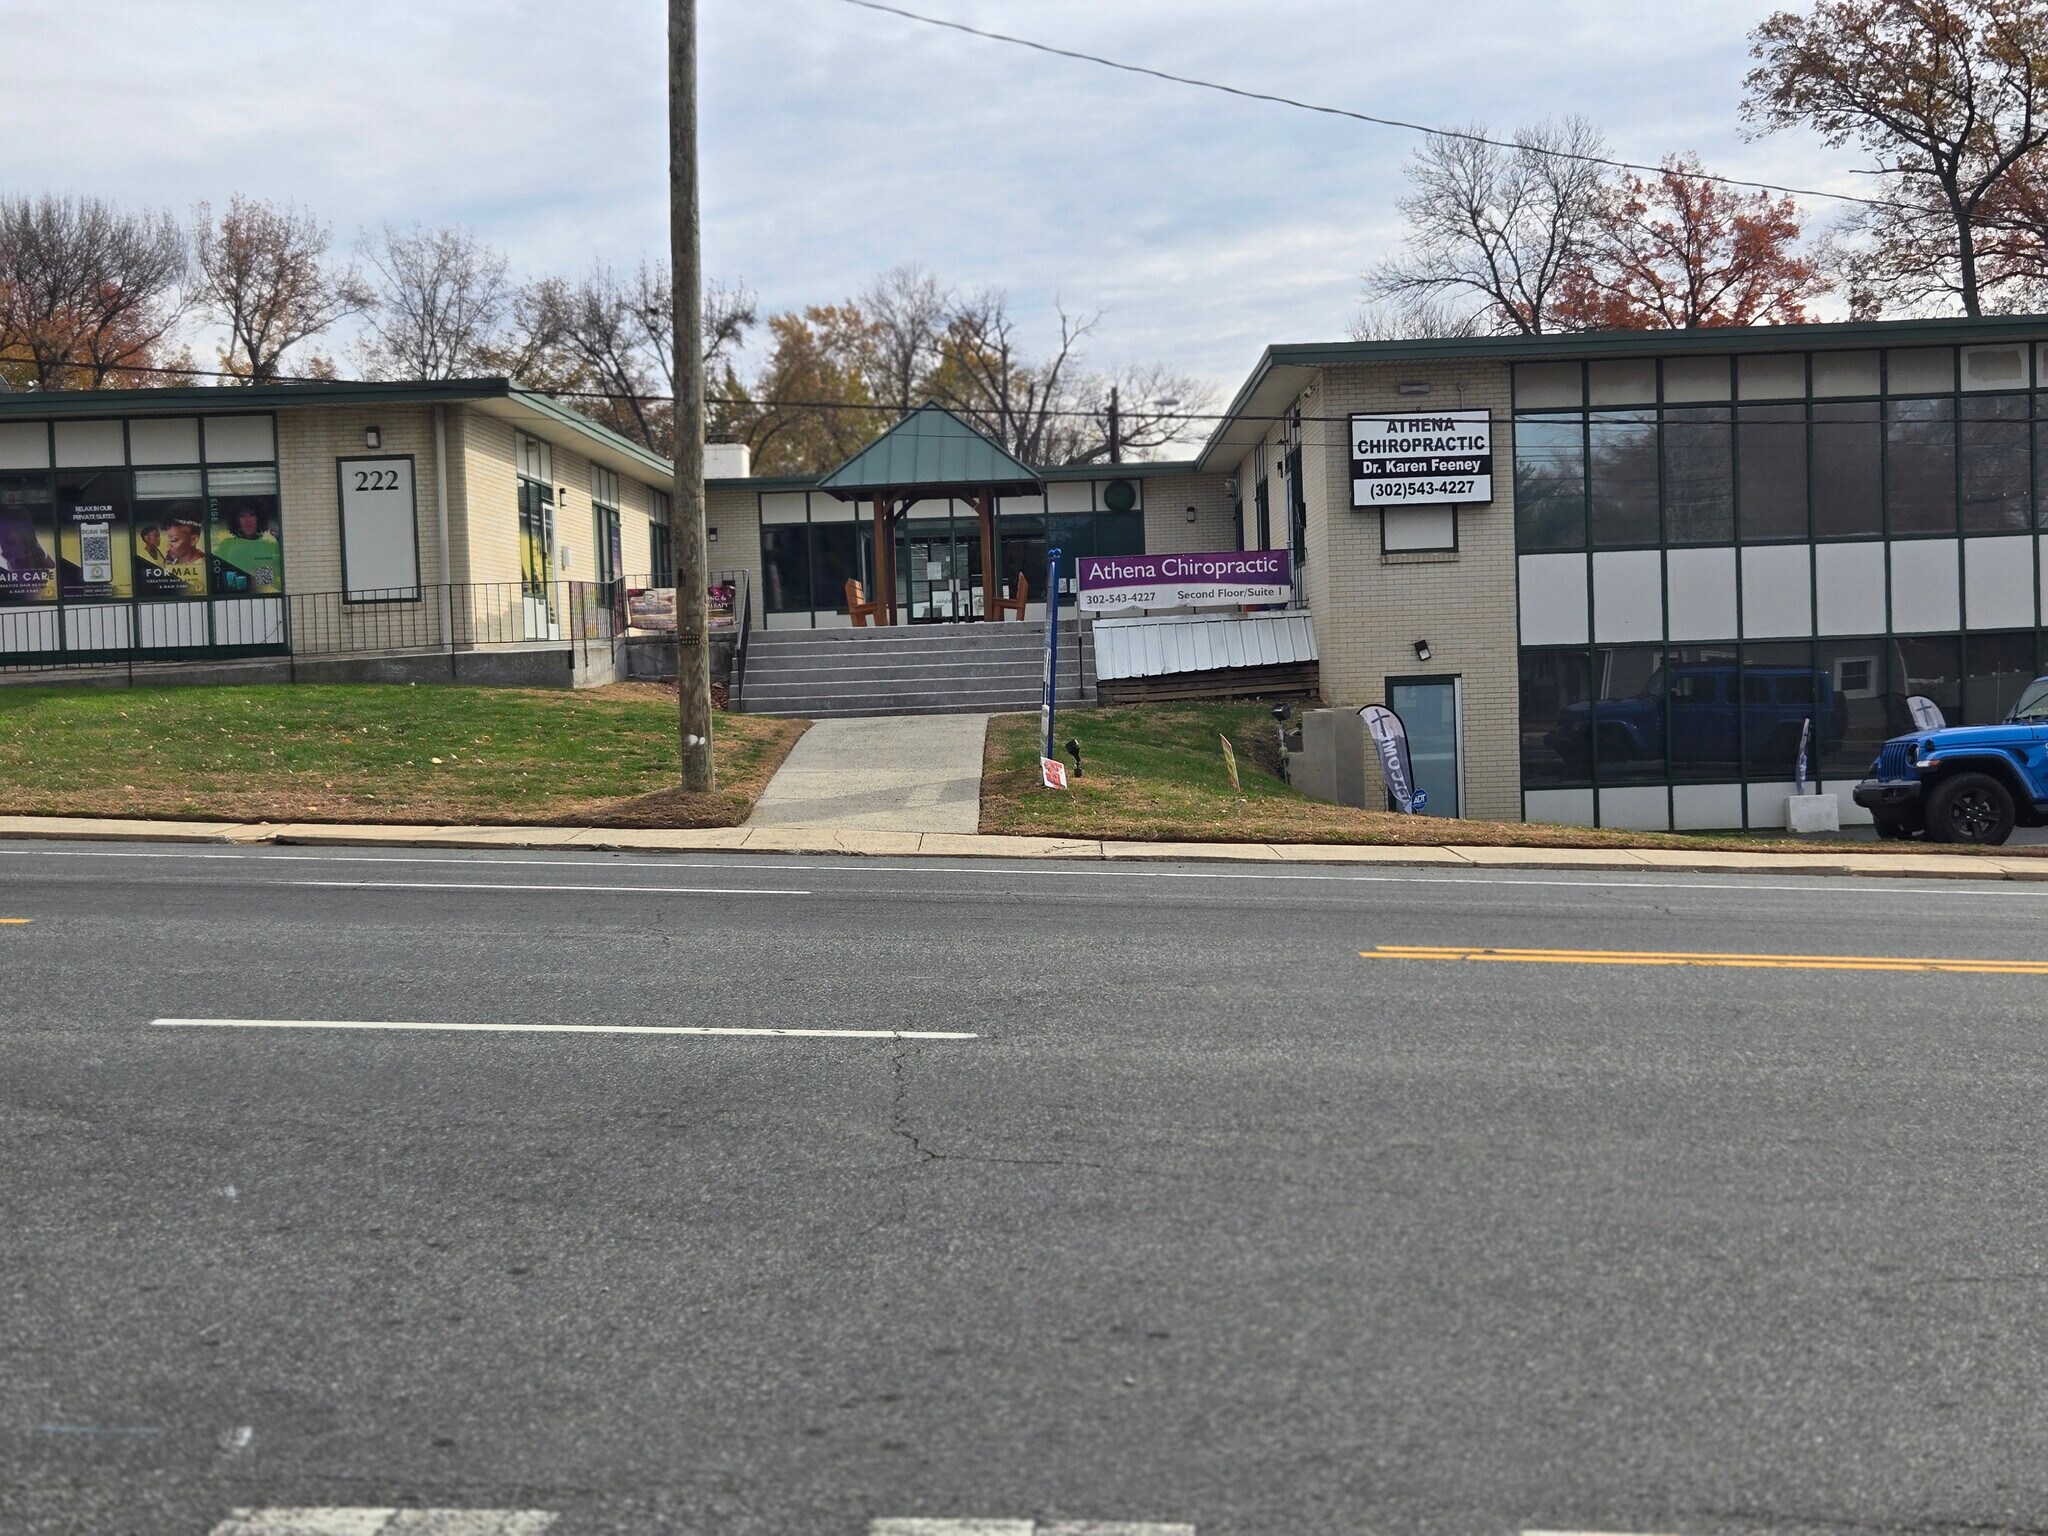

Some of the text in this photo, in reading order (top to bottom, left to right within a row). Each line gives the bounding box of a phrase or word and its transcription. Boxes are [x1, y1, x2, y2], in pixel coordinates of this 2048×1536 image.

[1387, 417, 1456, 433] ATHENA
[1357, 436, 1485, 454] CHIROPRACTIC
[1363, 458, 1481, 474] Dr. Karen Feeney
[354, 470, 399, 492] 222
[1370, 480, 1475, 500] (302)543-4227
[23, 571, 54, 581] CARE
[146, 567, 199, 577] FORMAL
[1088, 556, 1279, 580] Athena Chiropractic
[1086, 592, 1156, 604] 302-543-4227
[1177, 589, 1215, 600] Second
[1218, 587, 1274, 598] Floor/Suite
